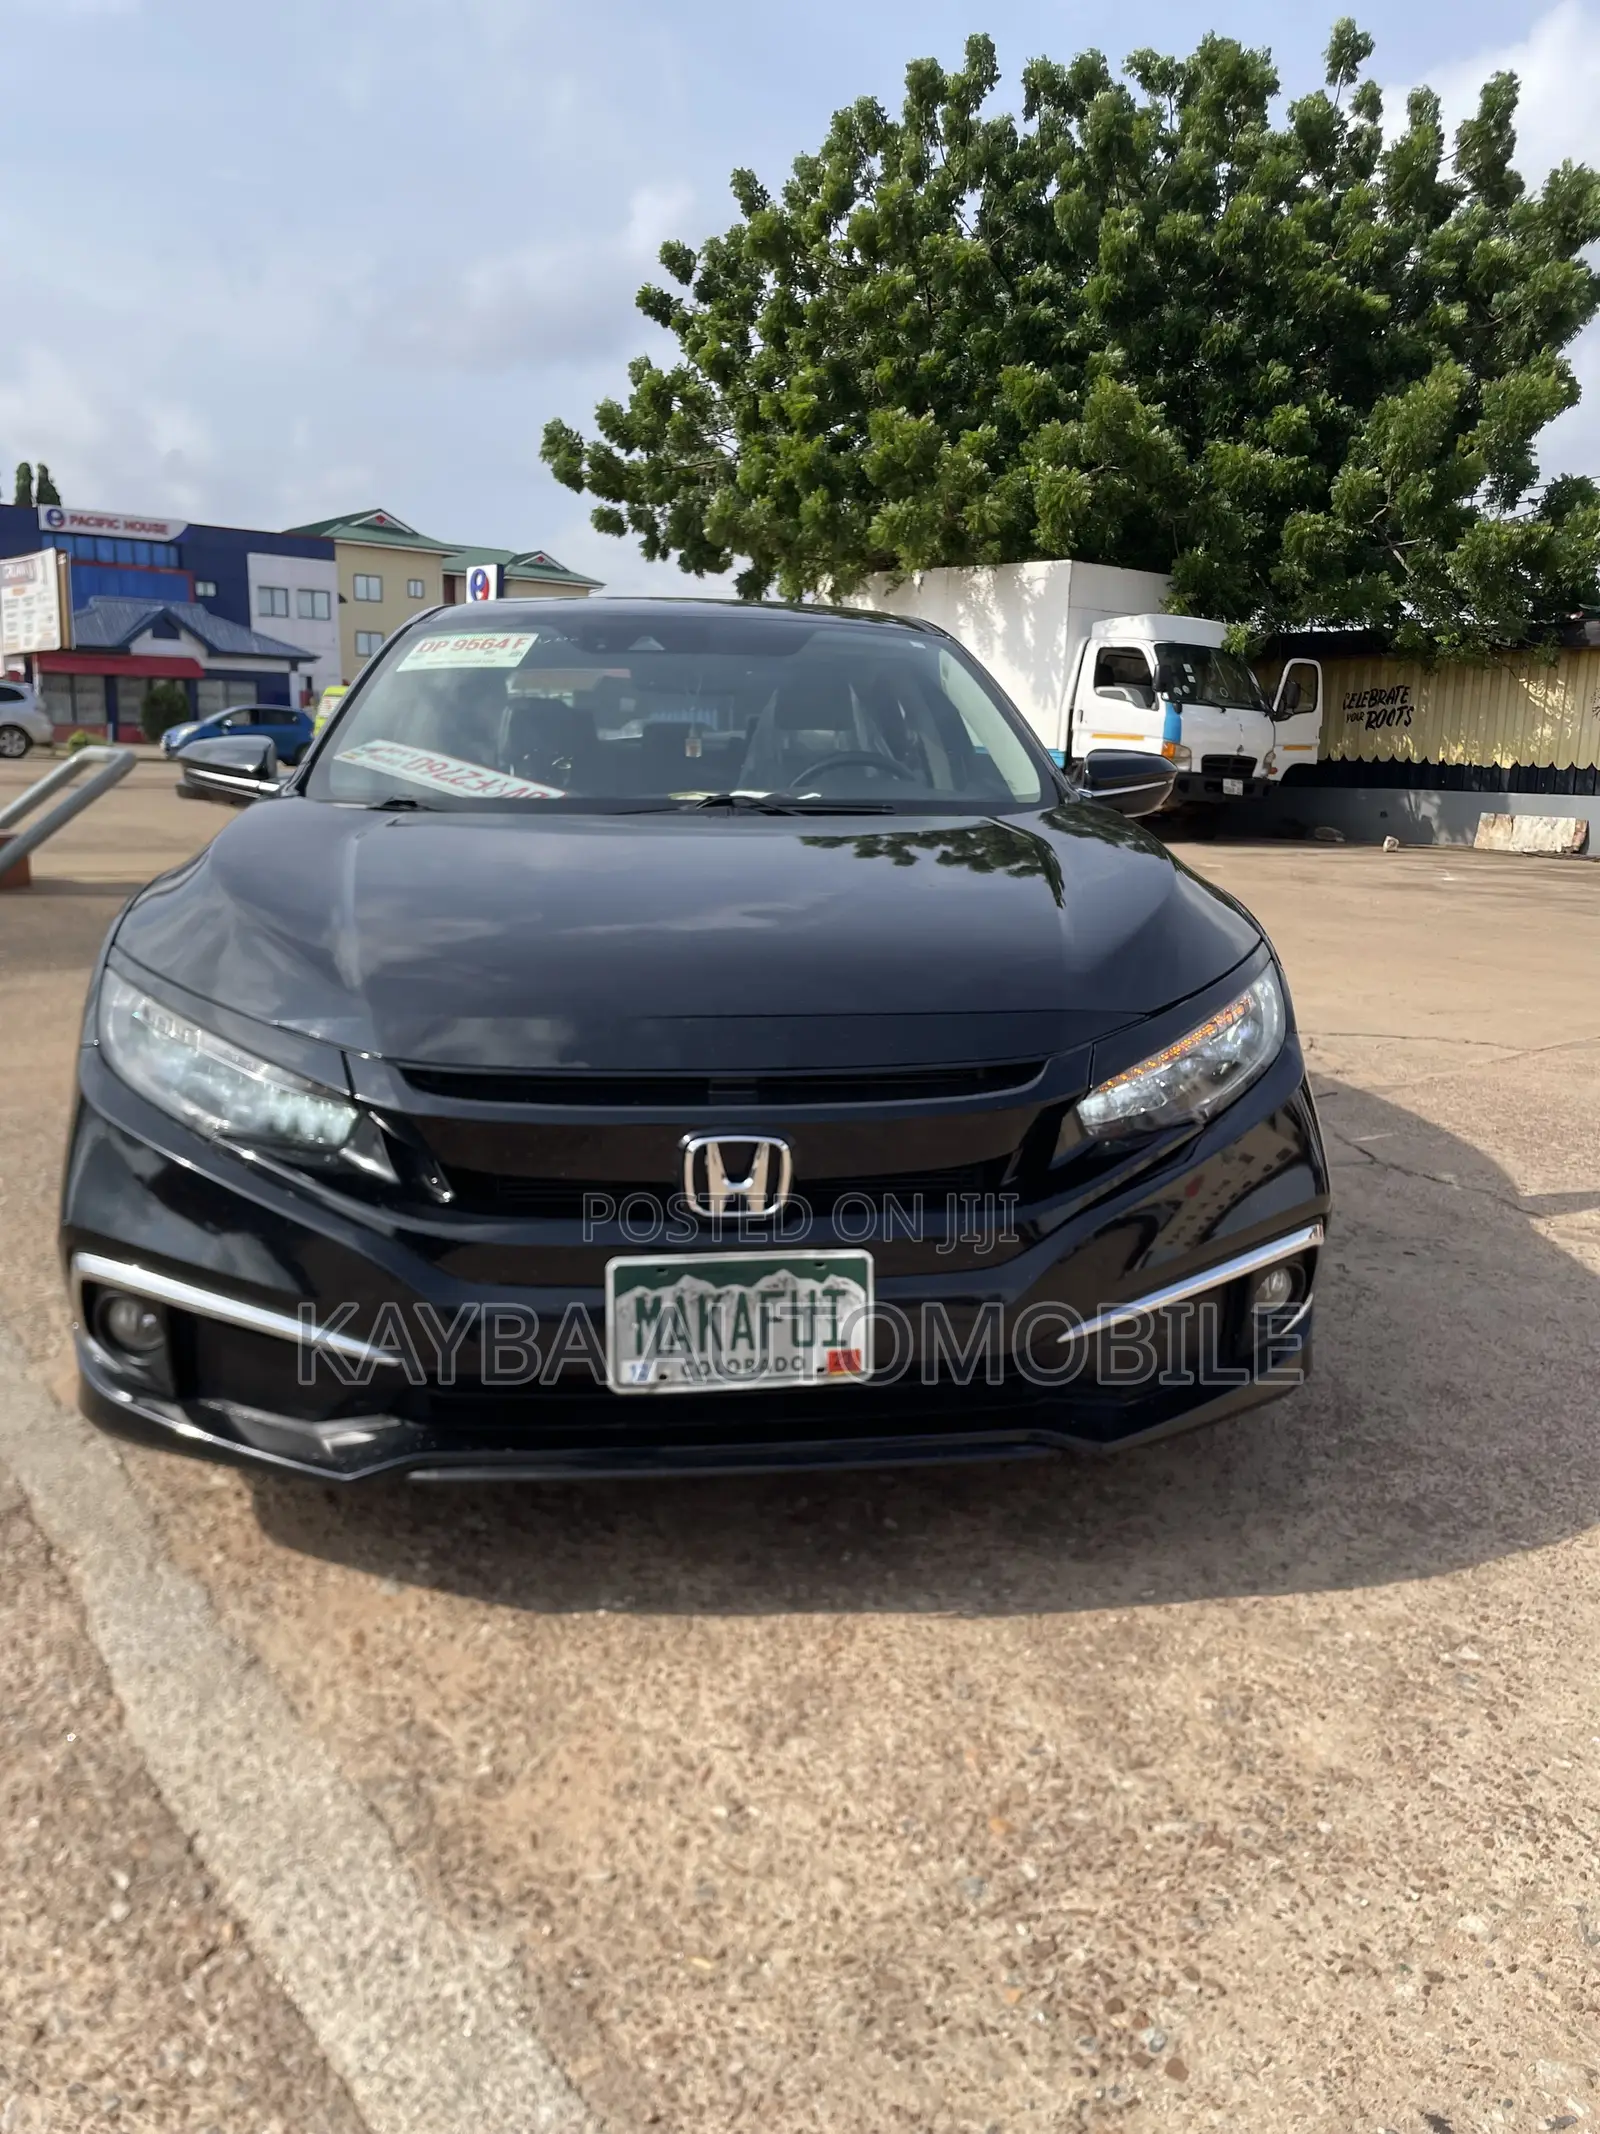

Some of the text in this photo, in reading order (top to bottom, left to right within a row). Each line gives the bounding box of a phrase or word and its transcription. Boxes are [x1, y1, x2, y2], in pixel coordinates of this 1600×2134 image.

[69, 514, 169, 535] PACIFIC HOUSE
[419, 637, 530, 652] DP 9564 F
[1343, 685, 1411, 711] CELEBRATE
[1346, 705, 1415, 731] YOUR ROOTS
[635, 1289, 847, 1356] MAKAFUI
[680, 1356, 807, 1377] COLORADO
